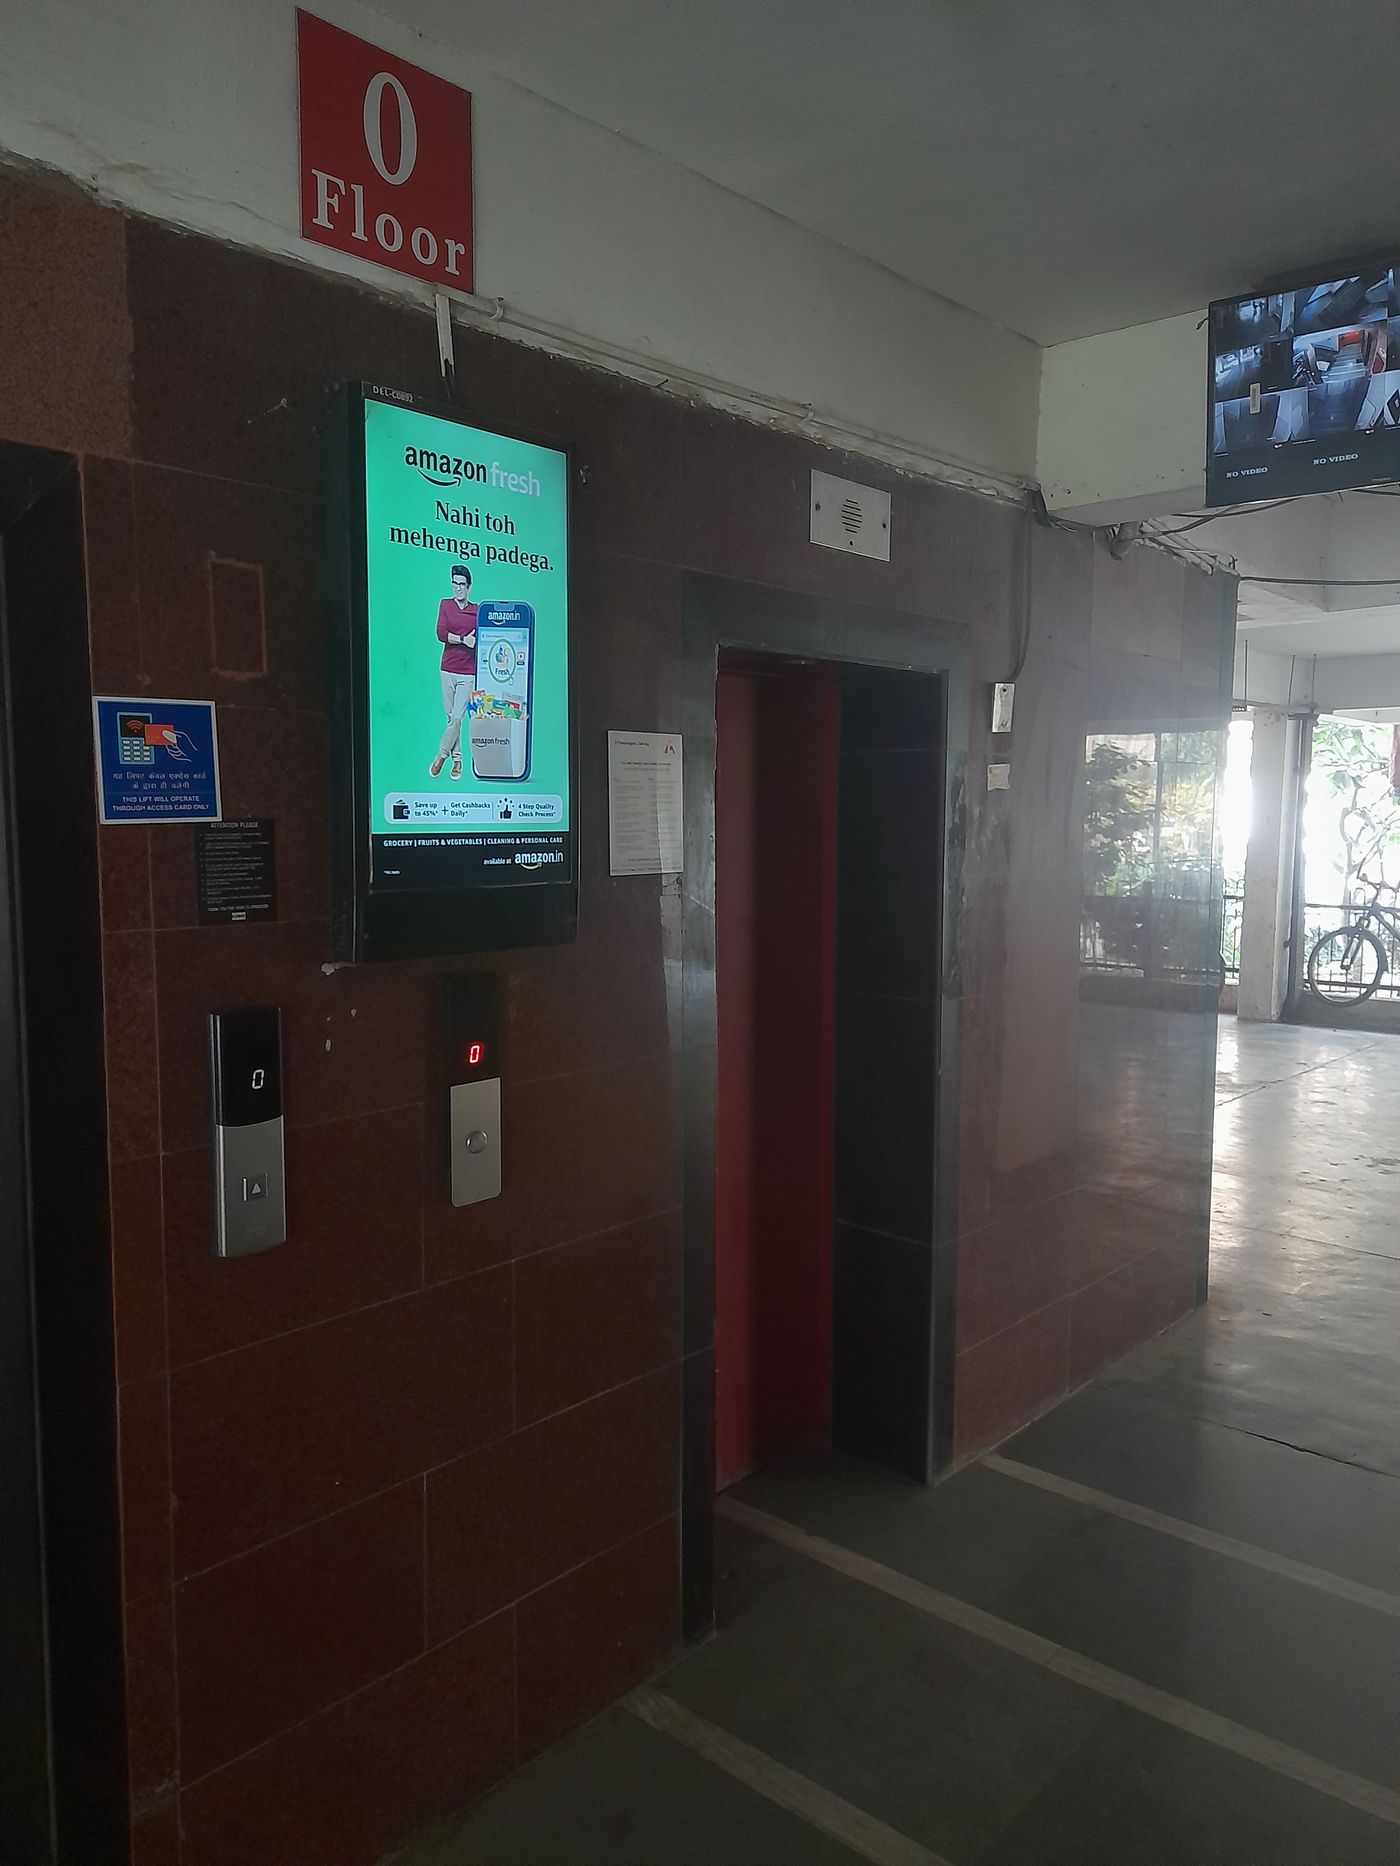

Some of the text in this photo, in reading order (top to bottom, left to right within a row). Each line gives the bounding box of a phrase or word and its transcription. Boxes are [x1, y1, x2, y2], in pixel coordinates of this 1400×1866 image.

[363, 71, 418, 186] 0
[310, 168, 467, 276] Floor
[1312, 453, 1359, 466] NO VIDEO
[404, 445, 541, 496] amazon fresh
[1226, 467, 1269, 479] NO VIDEO
[435, 499, 516, 536] Nahi toh
[389, 526, 555, 573] mehenga padega.
[495, 667, 510, 676] Fresh
[472, 737, 511, 748] amazon fresh
[170, 795, 200, 803] OPERATE
[450, 801, 491, 809] Get Cashbacks
[414, 801, 438, 811] Save up
[524, 803, 535, 811] Step
[536, 803, 555, 812] Quality
[383, 839, 413, 847] GROCERY
[447, 838, 483, 846] VEGETABLES
[469, 1044, 480, 1064] 0
[252, 1069, 265, 1090] 0
